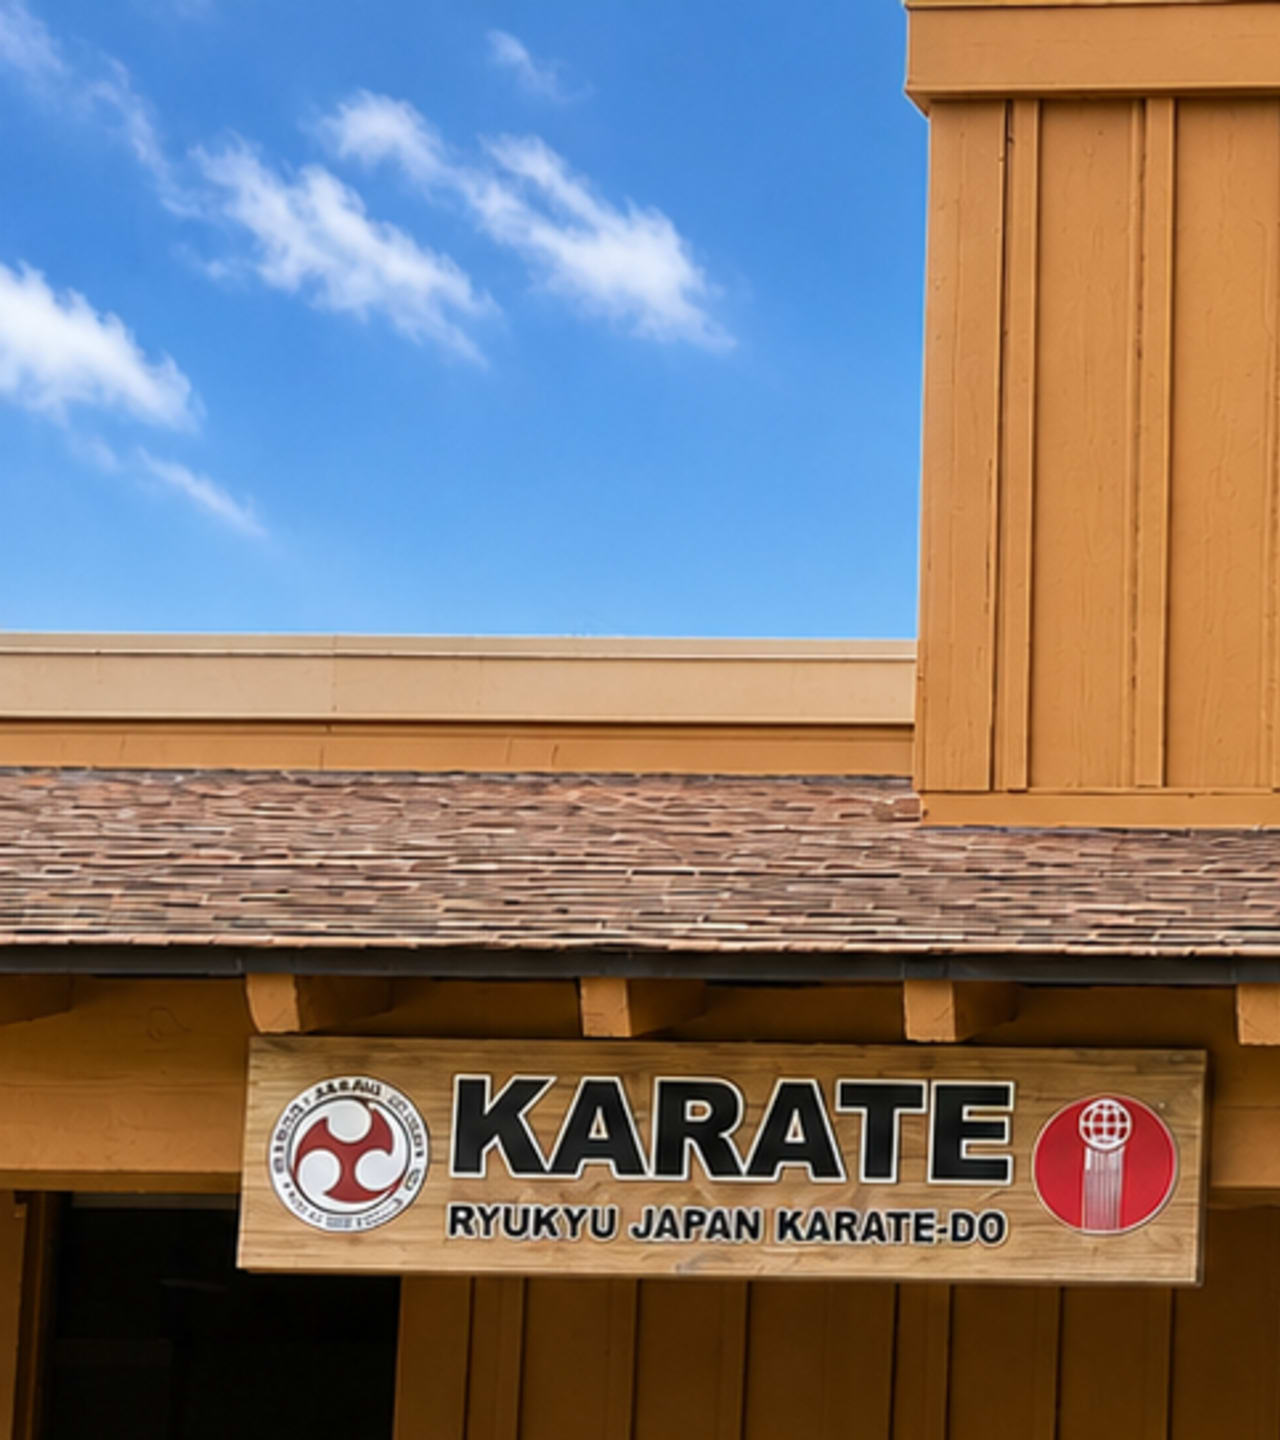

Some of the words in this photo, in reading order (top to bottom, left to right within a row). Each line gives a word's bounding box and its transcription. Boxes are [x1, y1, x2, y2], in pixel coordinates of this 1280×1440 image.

[451, 1075, 1014, 1184] KARATE
[449, 1204, 617, 1239] RYUKYU
[630, 1207, 761, 1241] JAPAN
[776, 1209, 1006, 1245] KARATE-DO
